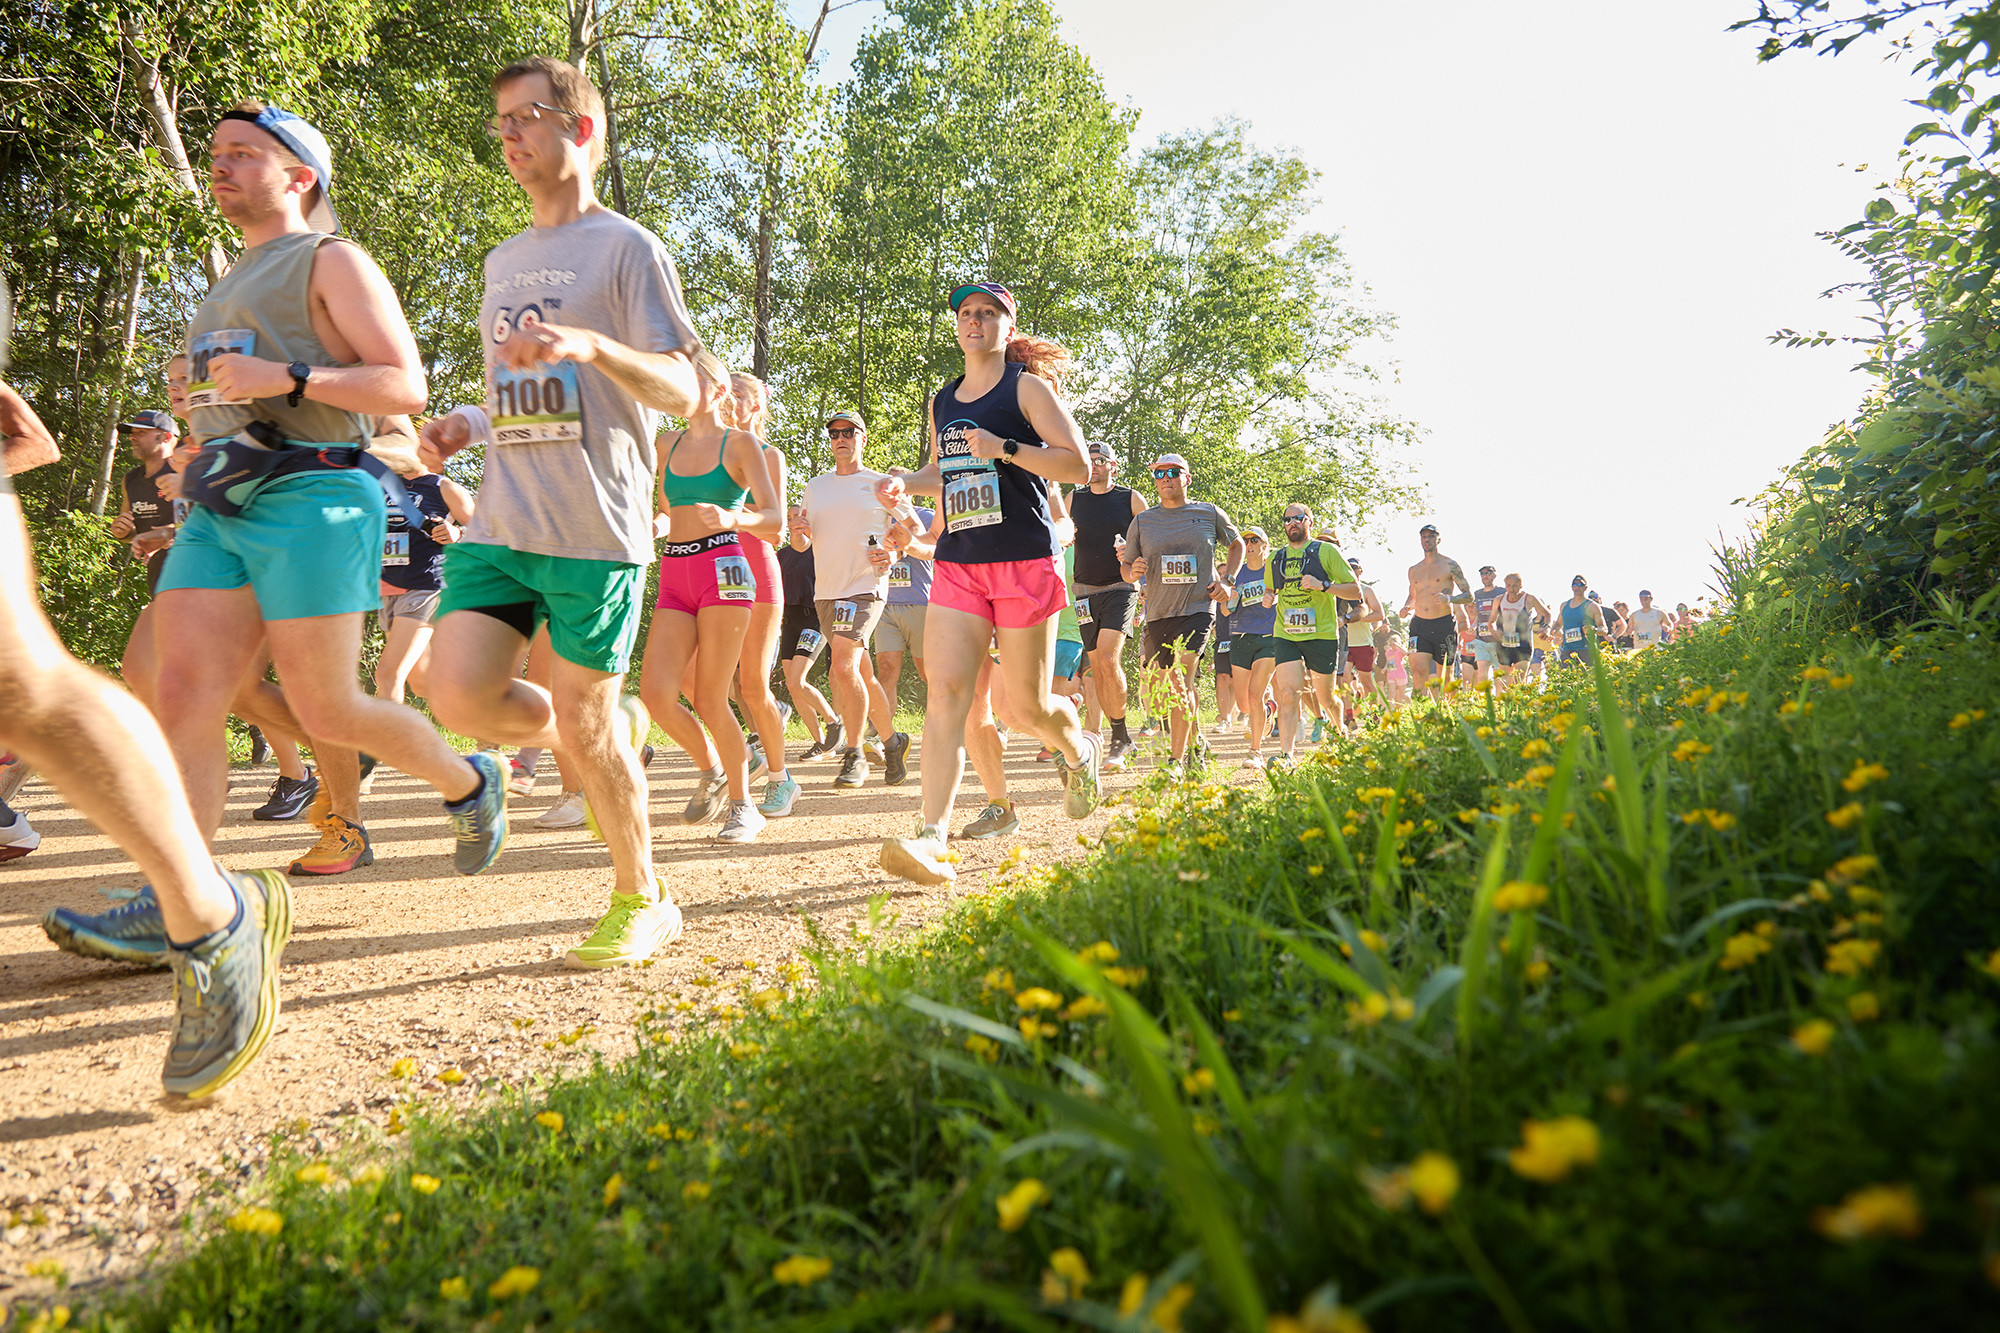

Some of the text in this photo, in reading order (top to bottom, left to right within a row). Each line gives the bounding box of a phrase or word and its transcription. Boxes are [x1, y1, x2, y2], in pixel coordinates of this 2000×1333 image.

[968, 456, 990, 467] CLUB
[948, 484, 995, 516] 1089
[670, 542, 702, 555] PRO
[707, 533, 739, 548] NIKE
[1166, 561, 1192, 576] 968
[1243, 585, 1265, 599] 603
[1289, 613, 1309, 626] 479
